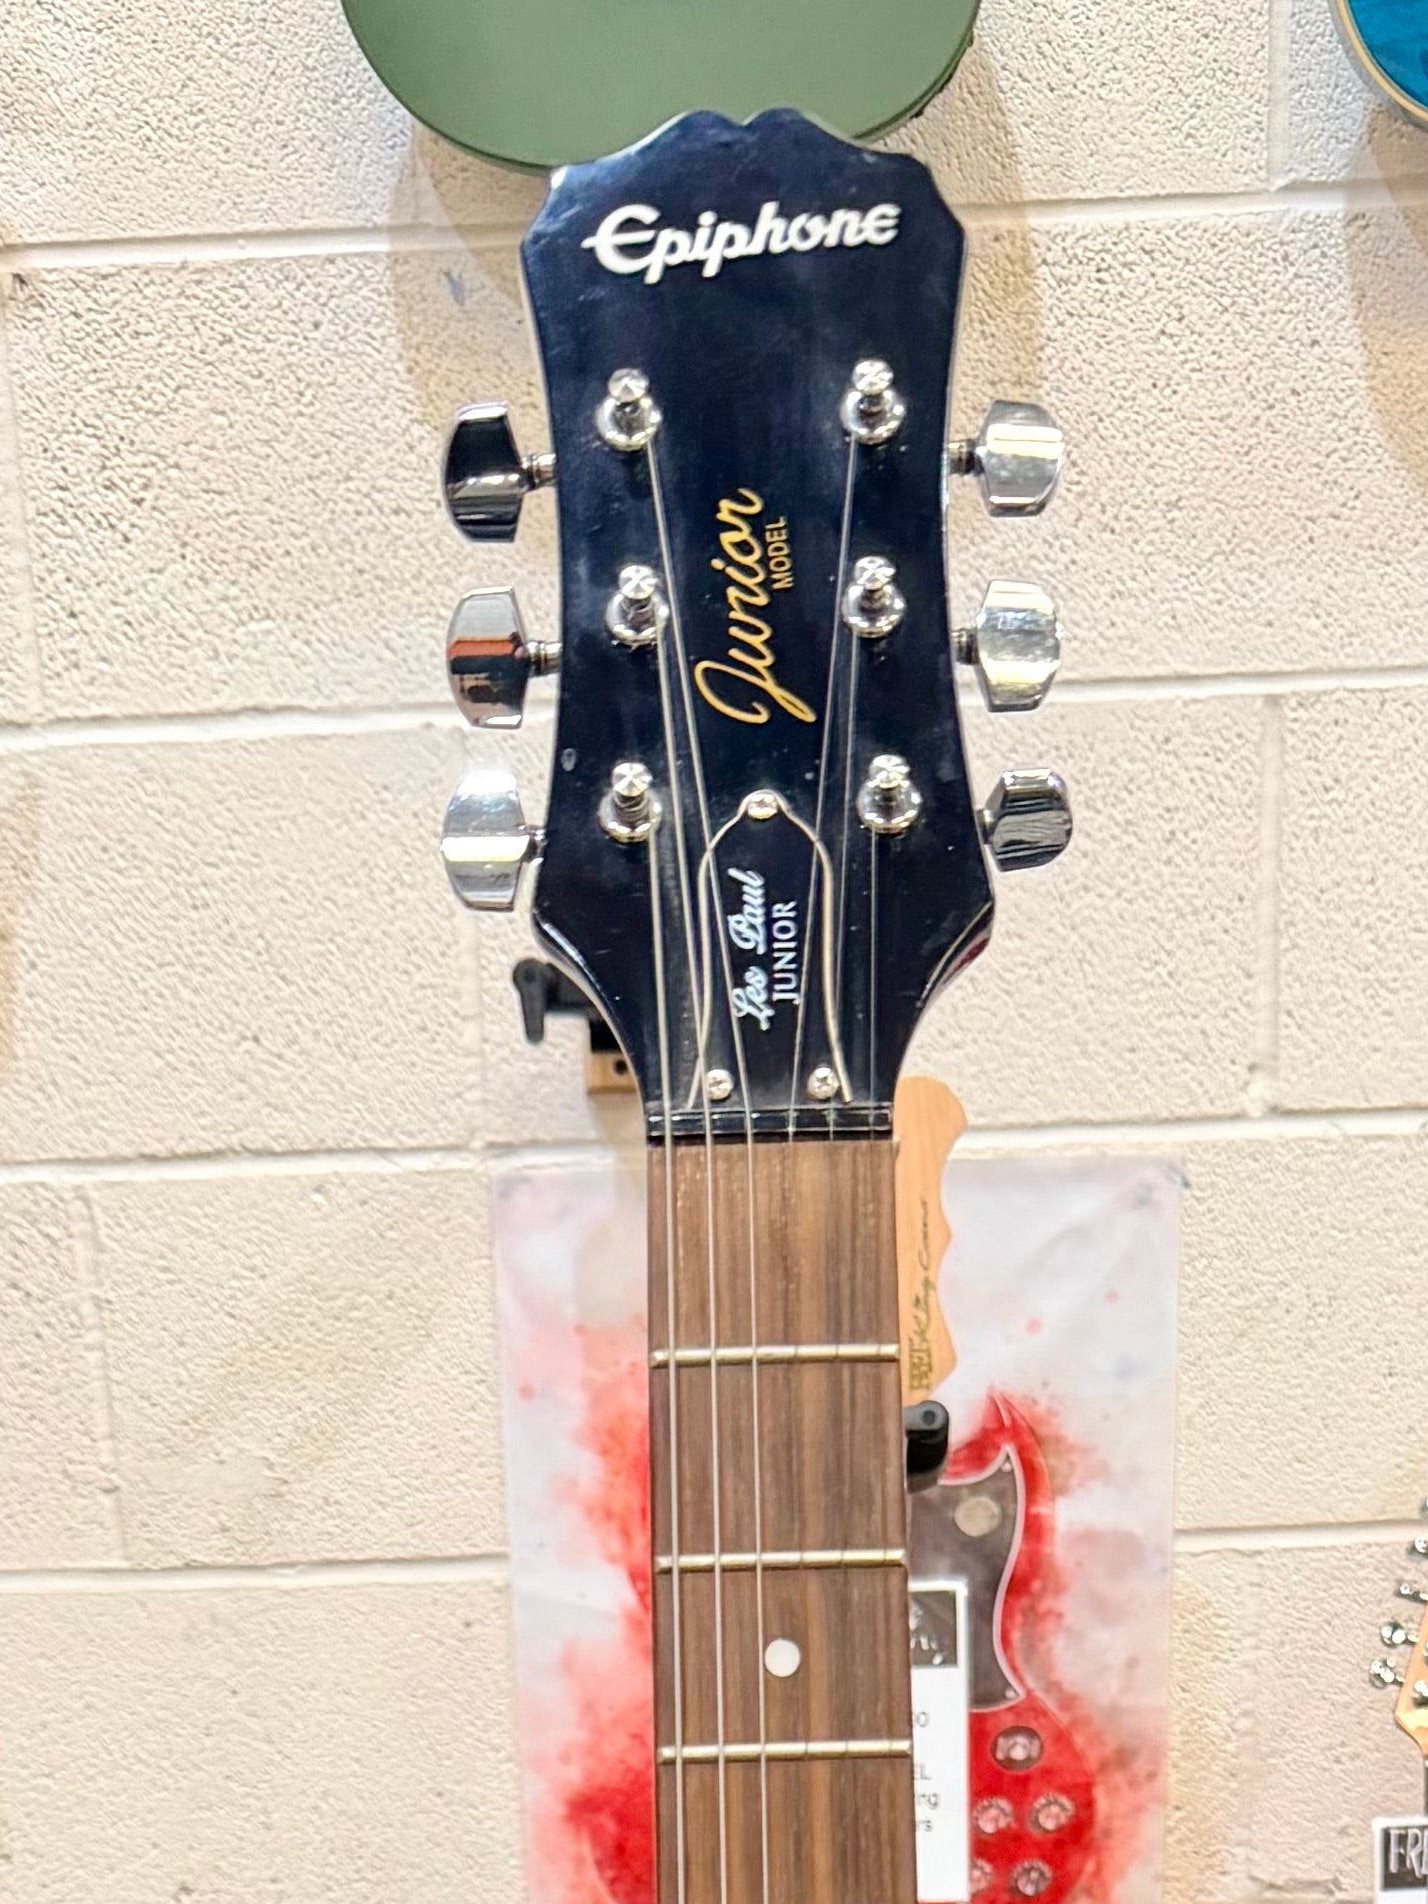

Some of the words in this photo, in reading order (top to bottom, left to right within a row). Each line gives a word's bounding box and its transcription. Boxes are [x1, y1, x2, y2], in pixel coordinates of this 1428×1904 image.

[581, 199, 900, 284] Epiphone
[771, 514, 793, 591] MODEL
[694, 487, 815, 724] Junior
[727, 868, 766, 955] Paul
[772, 901, 802, 1006] JUNIOR
[731, 966, 775, 1031] Les
